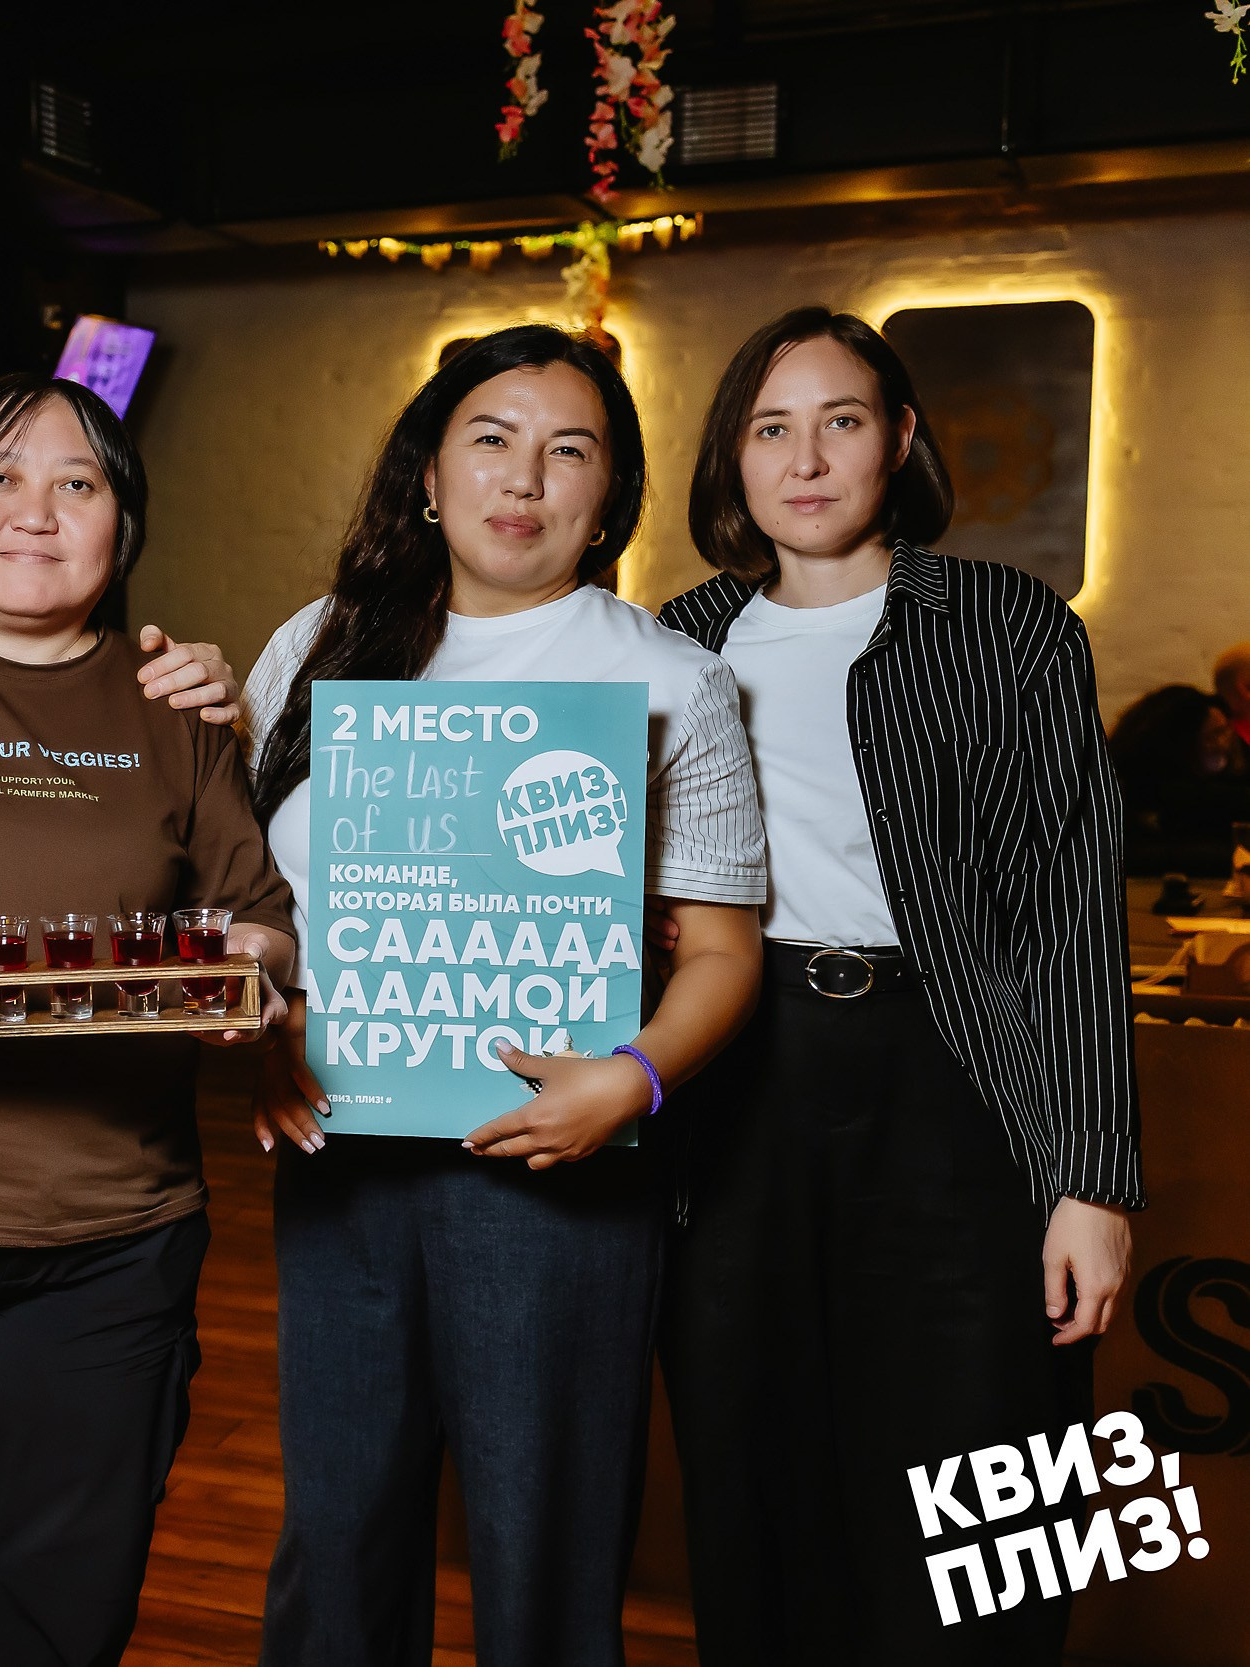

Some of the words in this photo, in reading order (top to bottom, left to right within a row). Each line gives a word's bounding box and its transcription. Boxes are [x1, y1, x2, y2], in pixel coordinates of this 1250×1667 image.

[331, 704, 358, 741] 2
[372, 705, 539, 743] МЕСТО
[37, 743, 141, 769] VEGGIES!
[46, 777, 76, 786] YOUR
[317, 745, 396, 799] The
[7, 788, 56, 799] FARMERS
[58, 790, 100, 802] MARKET
[501, 765, 625, 823] КВИЗ,
[331, 803, 381, 853] of
[502, 803, 628, 858] ПЛИЗ!
[329, 863, 459, 888] КОМАНДЕ,
[328, 890, 443, 911] КОТОРАЯ
[449, 894, 521, 913] БЫЛА
[526, 895, 612, 915] ПОЧТИ
[355, 1095, 384, 1104] ПЛИЗ!
